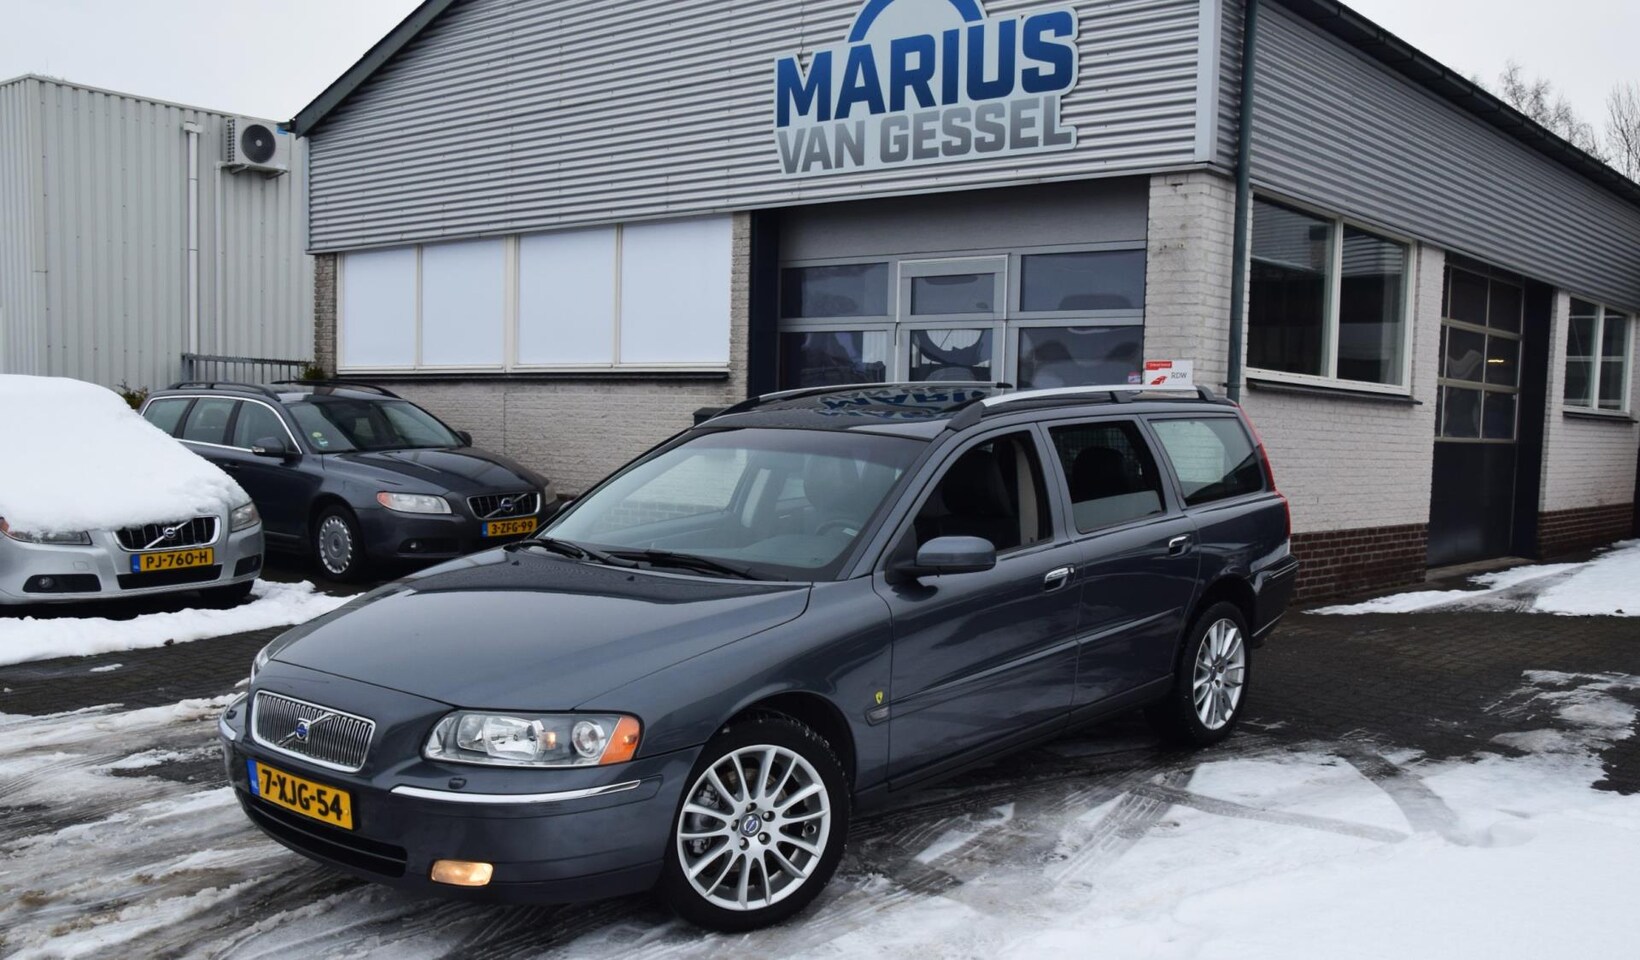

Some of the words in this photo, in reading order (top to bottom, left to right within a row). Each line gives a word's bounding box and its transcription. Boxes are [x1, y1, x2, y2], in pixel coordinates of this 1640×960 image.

[776, 10, 1074, 128] MARIUS
[777, 120, 866, 174] VAN
[880, 95, 1073, 164] GESSEL
[491, 521, 534, 534] 3-ZFG-99
[146, 551, 208, 569] PJ-760-H
[261, 769, 343, 821] 7-XJG-54
